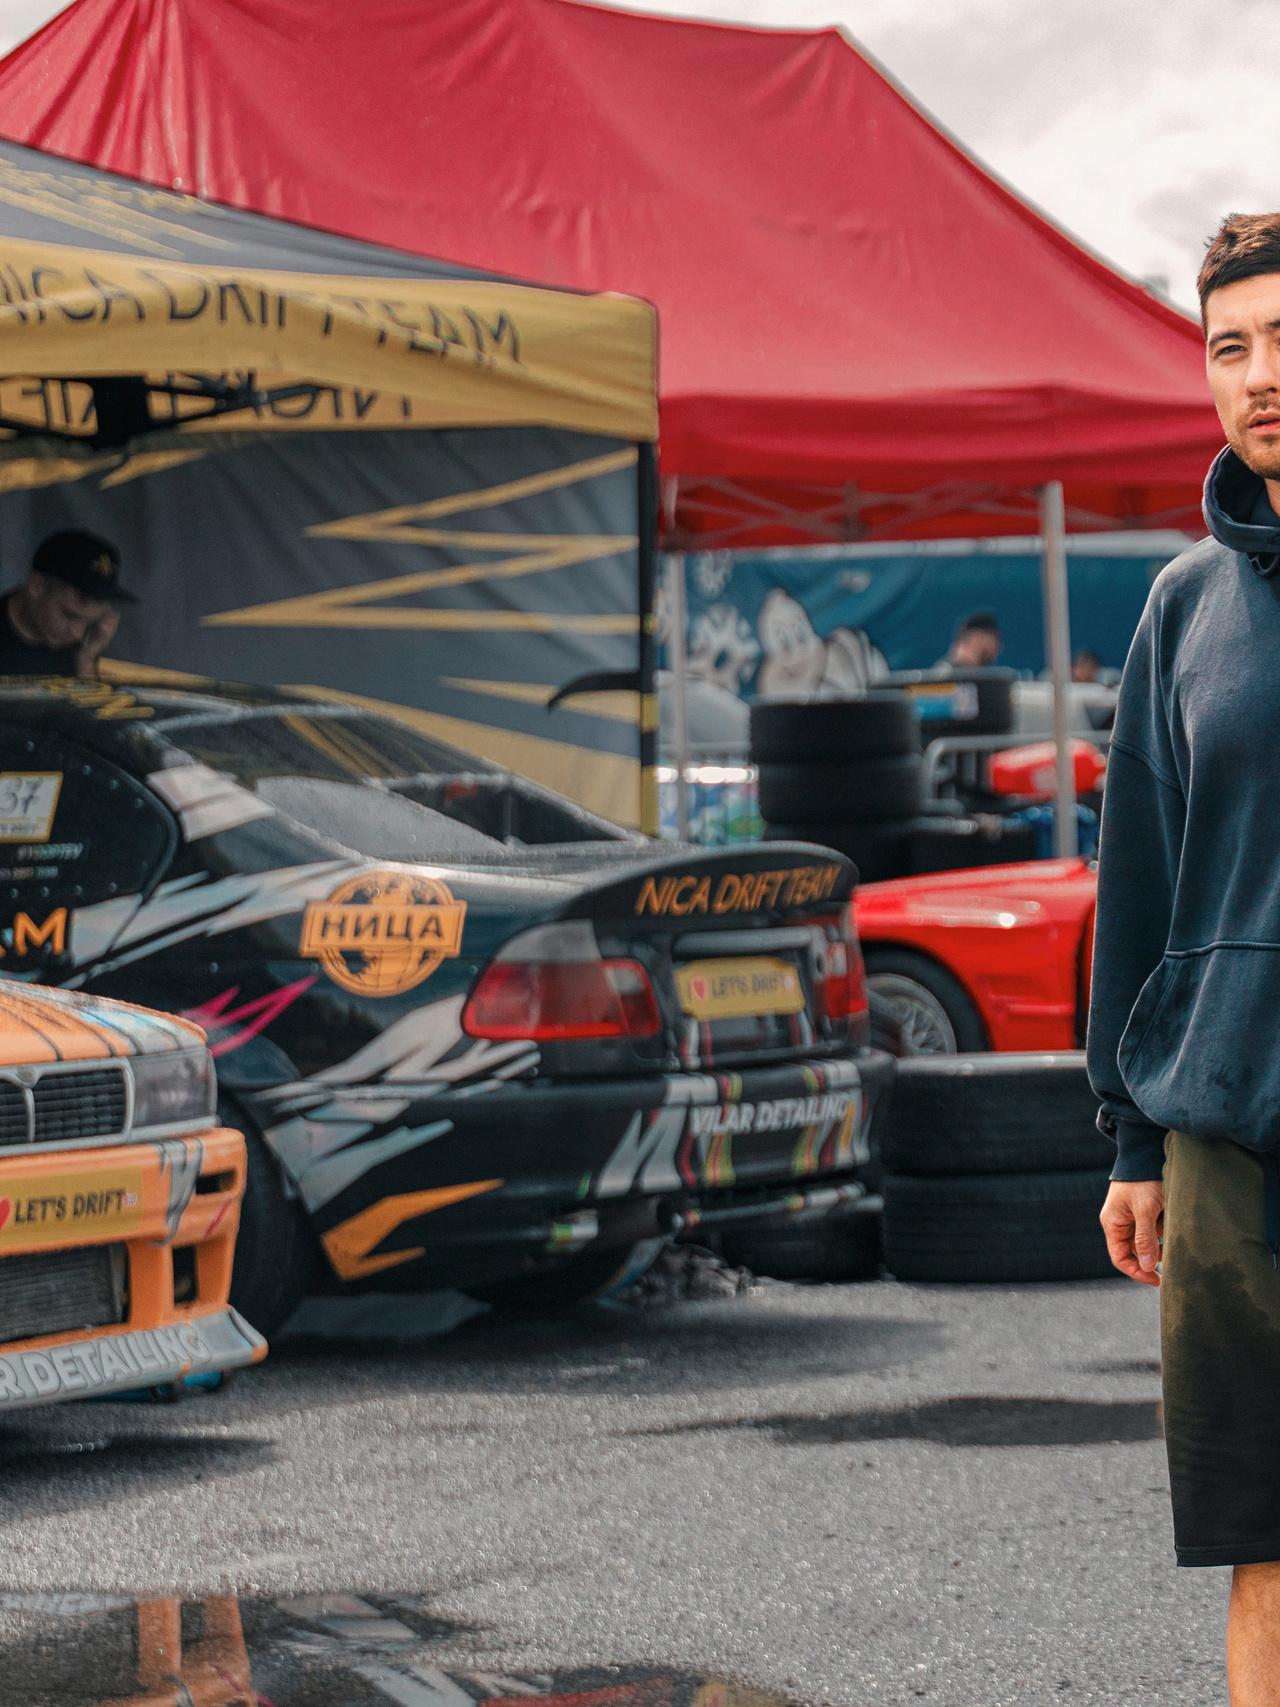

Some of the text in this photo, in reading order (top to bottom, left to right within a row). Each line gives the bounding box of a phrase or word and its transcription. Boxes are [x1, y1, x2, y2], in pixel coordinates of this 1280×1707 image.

[634, 862, 843, 917] NICA DRIFT TEAM
[0, 906, 68, 960] M
[320, 911, 446, 943] НИЦА
[690, 1090, 852, 1136] VILAR DETAILING
[14, 1194, 68, 1225] LET'S
[73, 1186, 126, 1218] DRIFT
[22, 1325, 213, 1398] DETAILING
